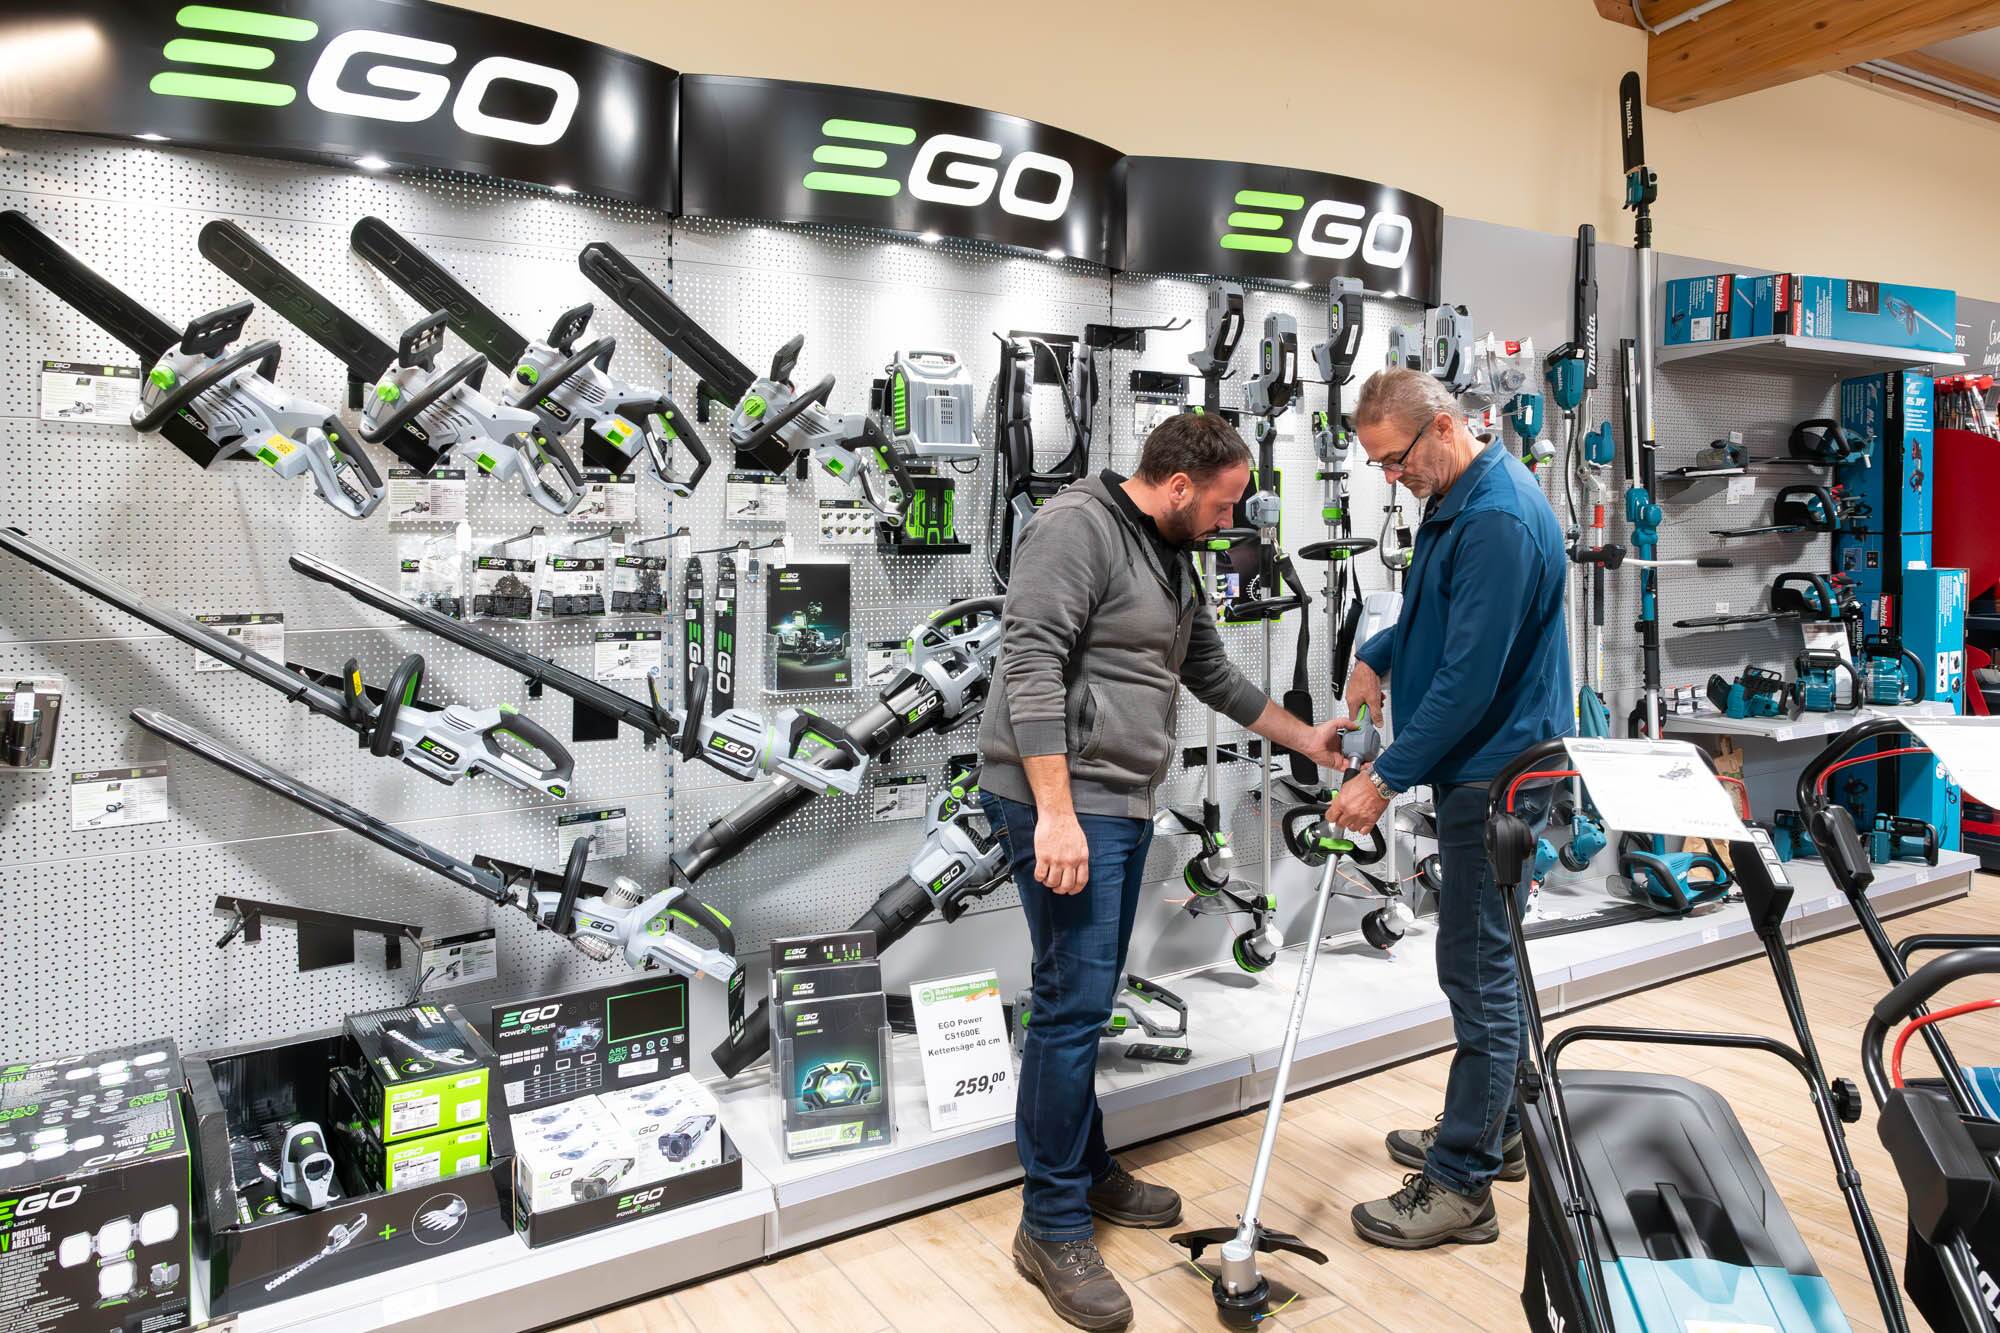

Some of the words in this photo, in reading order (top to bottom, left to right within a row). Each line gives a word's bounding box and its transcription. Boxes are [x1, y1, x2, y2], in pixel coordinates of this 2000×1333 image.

[149, 4, 580, 146] EGO
[802, 117, 1075, 222] EGO
[1219, 189, 1413, 270] EGO
[1331, 303, 1340, 330] EGO
[539, 397, 567, 418] EGO
[177, 408, 207, 431] EGO
[478, 557, 507, 567] EGO
[555, 560, 579, 569] EGO
[616, 557, 641, 565] EGO
[780, 572, 800, 580] EGO
[715, 630, 734, 694] EGO
[908, 696, 938, 723] EGO
[420, 741, 456, 761] EGO
[711, 735, 754, 759] EGO
[932, 865, 960, 893] EGO
[577, 915, 615, 932] EGO
[784, 947, 807, 956] EGO
[730, 970, 744, 990] EGO
[792, 982, 815, 991] EGO
[500, 1004, 560, 1029] EGO
[795, 1012, 819, 1022] EGO
[938, 1021, 956, 1030] EGO
[958, 1016, 983, 1027] Power
[499, 1027, 528, 1039] POWER
[531, 1022, 556, 1032] NEXUS
[944, 1028, 981, 1041] CS1600E
[976, 1039, 986, 1047] 40
[988, 1037, 1001, 1045] cm
[617, 1186, 666, 1210] EGO
[13, 1218, 37, 1228] LIGHT
[12, 1225, 47, 1241] PORTABLE
[12, 1236, 31, 1250] AREA
[31, 1231, 52, 1246] LIGHT
